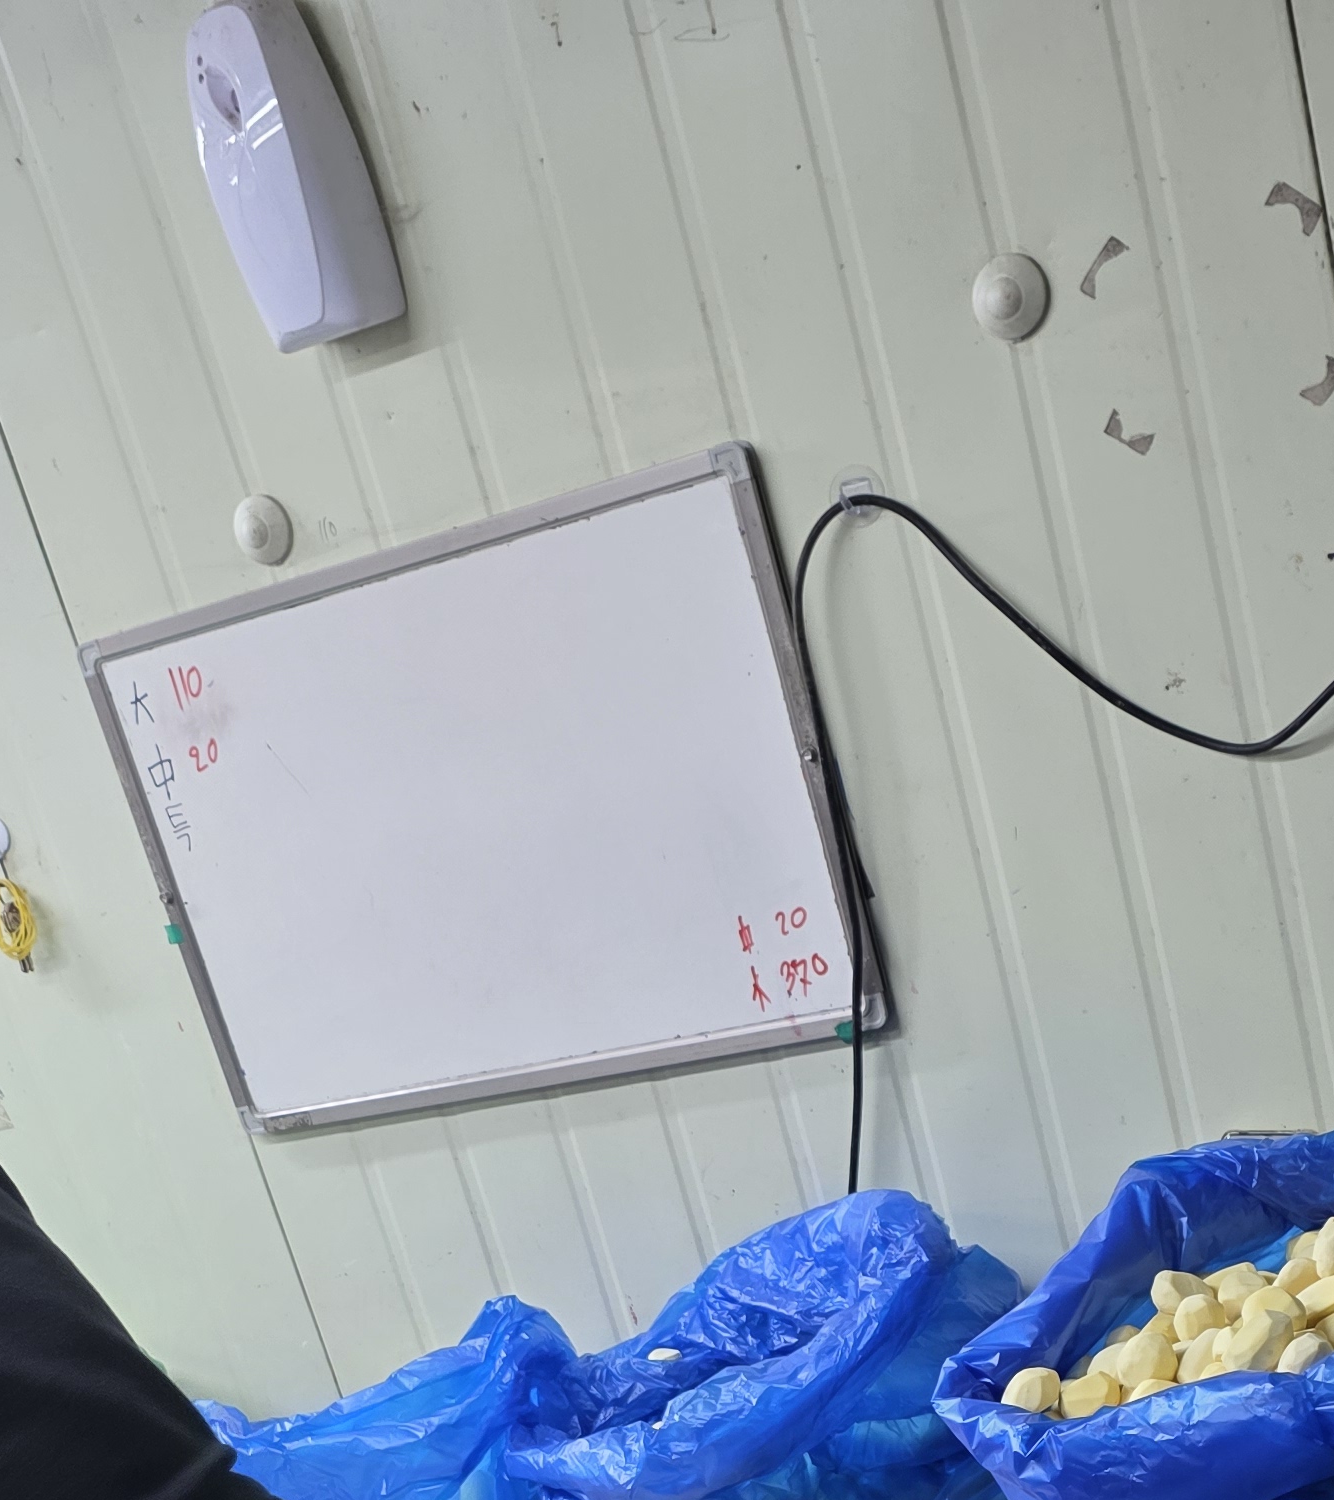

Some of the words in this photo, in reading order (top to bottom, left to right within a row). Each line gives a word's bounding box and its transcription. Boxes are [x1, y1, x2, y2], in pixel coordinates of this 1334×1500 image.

[168, 666, 202, 711] 110
[189, 738, 218, 772] 20
[775, 906, 807, 936] 20
